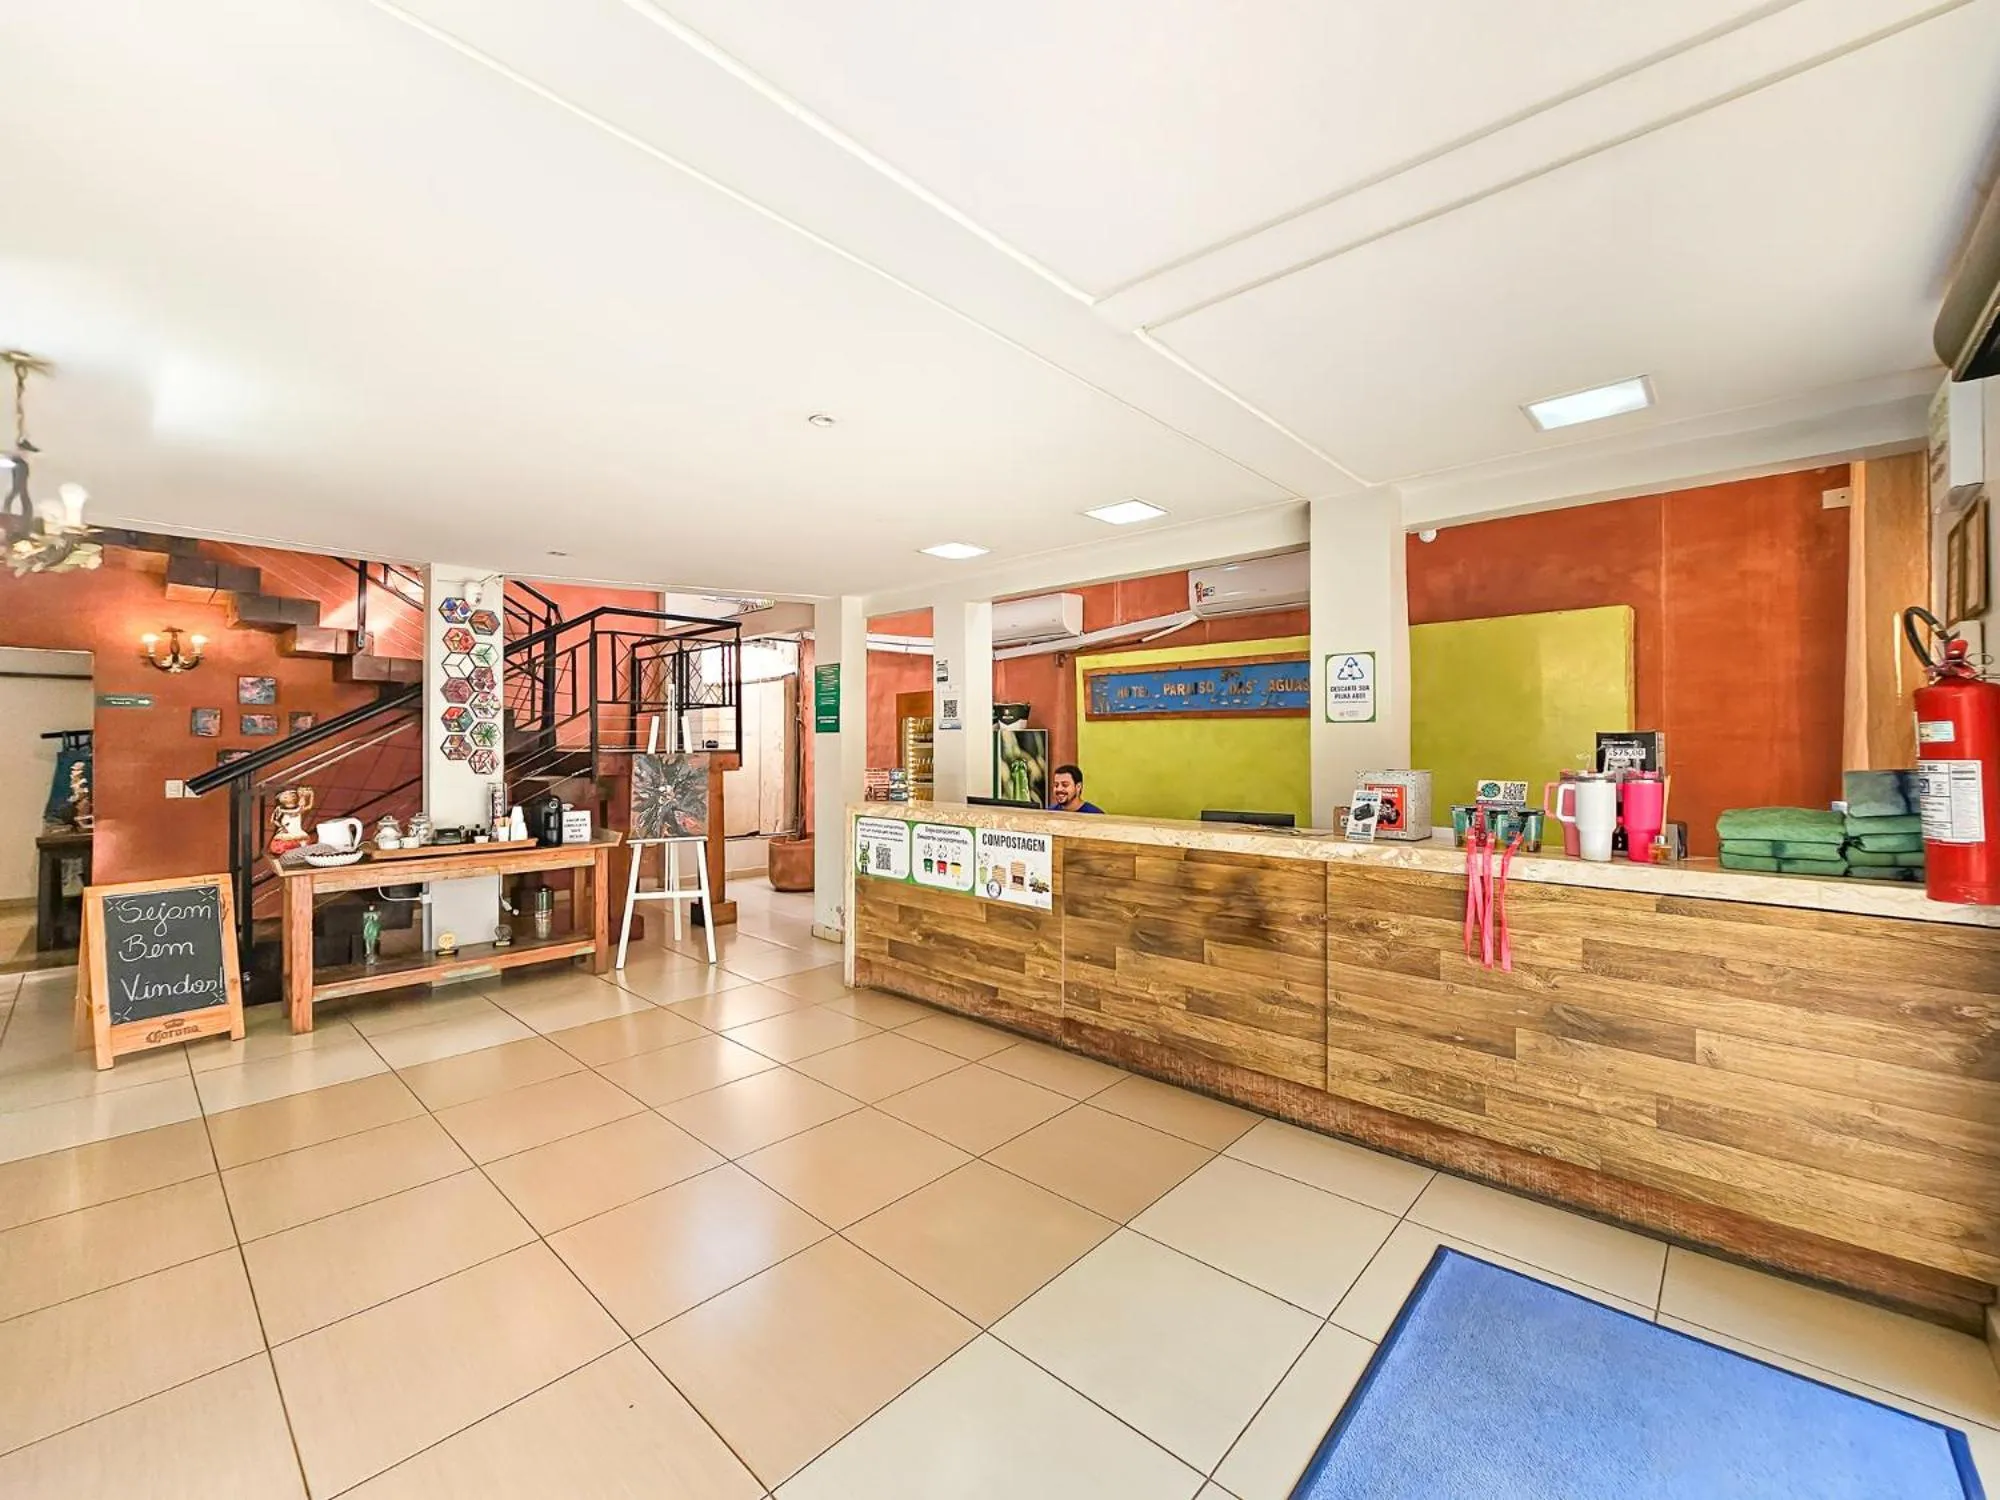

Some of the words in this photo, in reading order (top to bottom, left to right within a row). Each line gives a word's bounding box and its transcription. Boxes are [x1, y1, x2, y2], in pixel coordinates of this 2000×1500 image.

[1229, 680, 1253, 695] DAS
[981, 833, 1046, 852] COMPOSTAGEM
[118, 899, 212, 937] Sejam
[118, 933, 195, 962] Bem
[120, 966, 225, 1002] Vindos!
[146, 1025, 200, 1043] Corona
